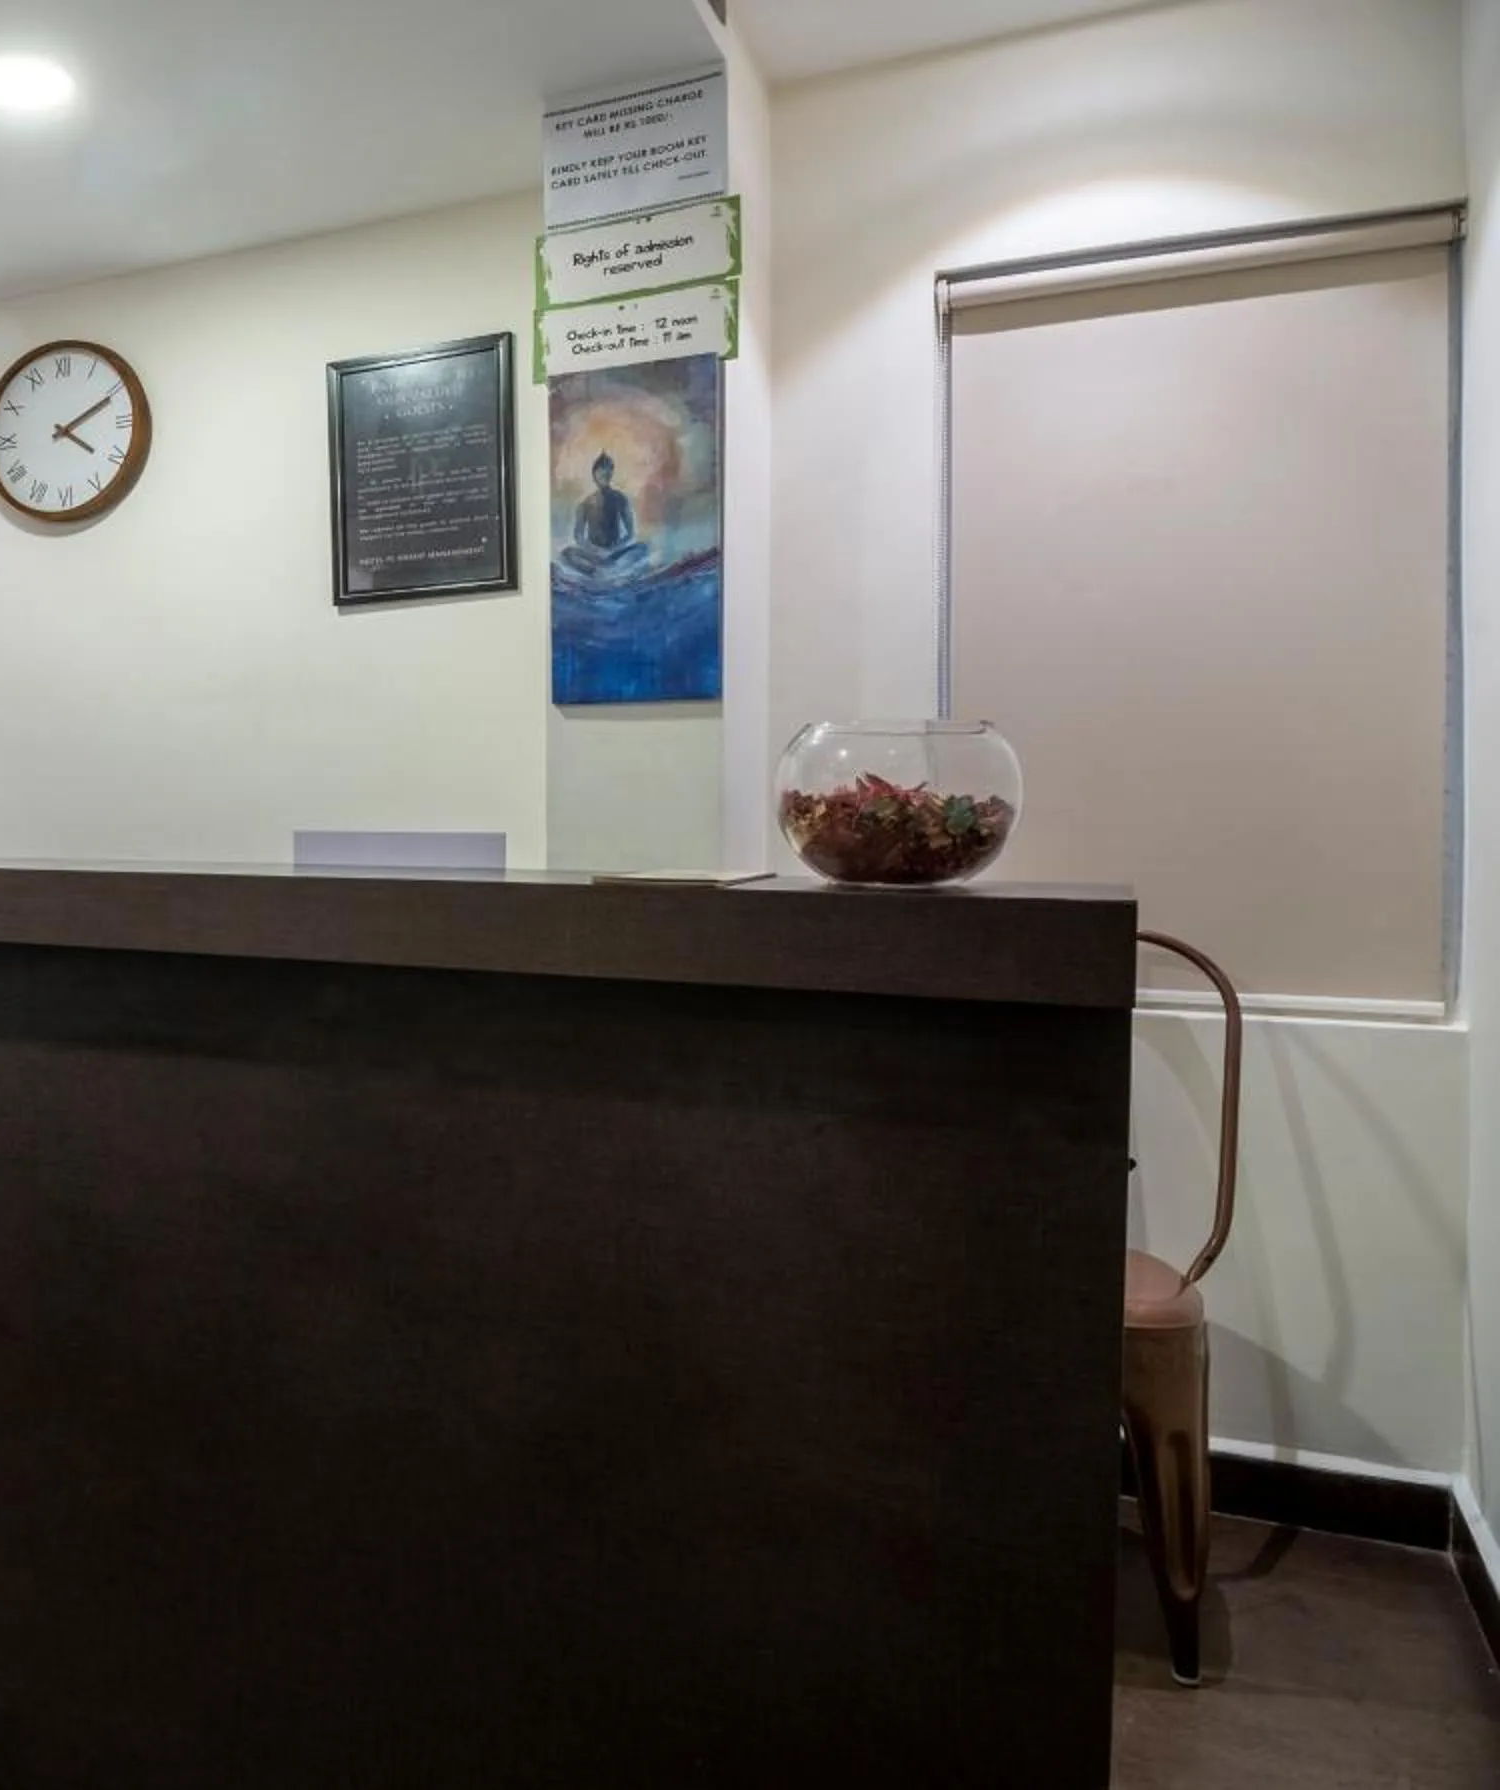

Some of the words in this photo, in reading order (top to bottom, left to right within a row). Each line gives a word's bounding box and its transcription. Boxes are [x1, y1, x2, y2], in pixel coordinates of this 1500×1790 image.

[555, 120, 574, 131] KEY
[577, 112, 606, 127] CARD
[609, 101, 654, 120] MISSING
[657, 89, 704, 109] CHARGE
[551, 160, 587, 176] KINDLY
[590, 155, 615, 168] KEEP
[618, 149, 648, 162] YOUR
[650, 140, 685, 156] ROOM
[687, 135, 707, 146] KEY
[551, 177, 581, 190] CARD
[573, 249, 611, 268] Rights
[615, 243, 631, 258] of
[635, 235, 695, 253] admission
[604, 254, 663, 276] reserved
[566, 327, 612, 341] Check-in
[655, 317, 667, 329] 12
[671, 315, 698, 327] noon
[572, 337, 625, 355] Check-out
[662, 332, 672, 343] 11
